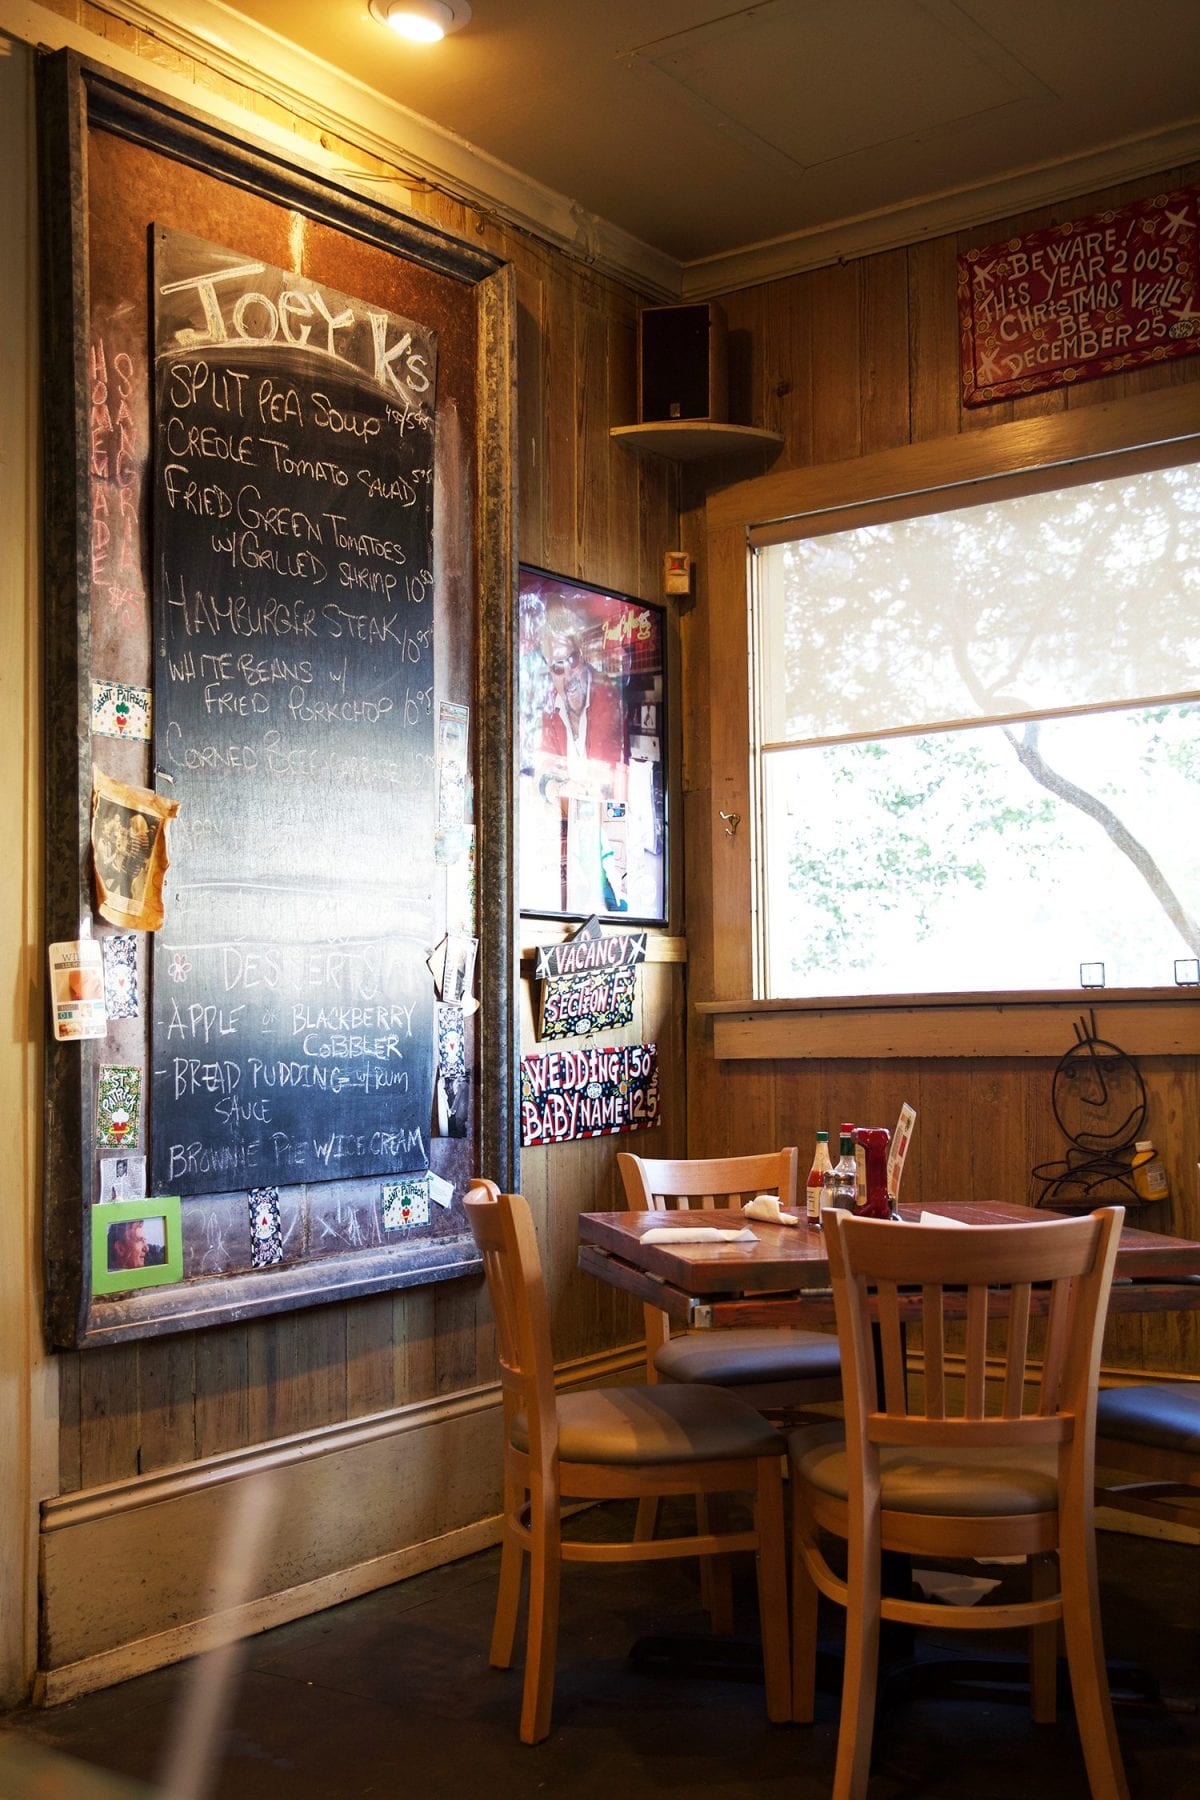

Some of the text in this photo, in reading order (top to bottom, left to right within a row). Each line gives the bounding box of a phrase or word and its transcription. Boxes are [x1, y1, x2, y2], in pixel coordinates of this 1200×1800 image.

[1008, 219, 1136, 281] BEWARE!
[1041, 255, 1106, 304] YEAR
[1111, 248, 1178, 274] 2005
[1057, 312, 1092, 339] BE
[1002, 324, 1132, 379] DECEMBER
[170, 361, 249, 416] SPLIT
[259, 380, 303, 427] PEA
[167, 417, 257, 472] CREOLE
[357, 470, 416, 507] SALAD
[164, 464, 232, 518] FRIED
[237, 485, 322, 545] GREEN
[339, 563, 396, 601] SHRIMP
[165, 575, 317, 637] HAMBURGER
[322, 603, 401, 644] STEAK
[168, 651, 235, 684] WHITE
[237, 653, 313, 686] BEANS
[204, 682, 270, 717] FRIED
[166, 722, 258, 770] CORNED
[263, 730, 318, 775] BEEF
[555, 935, 630, 975] VACANCY
[610, 969, 632, 1013] F
[291, 1000, 417, 1037] BLACKBERRY
[303, 1033, 402, 1060] COBBLER
[111, 1073, 129, 1089] ST
[215, 1096, 272, 1126] SAUCE
[522, 1092, 580, 1141] BABY
[168, 1140, 260, 1181] BROWNIE
[369, 1125, 429, 1170] CREAM
